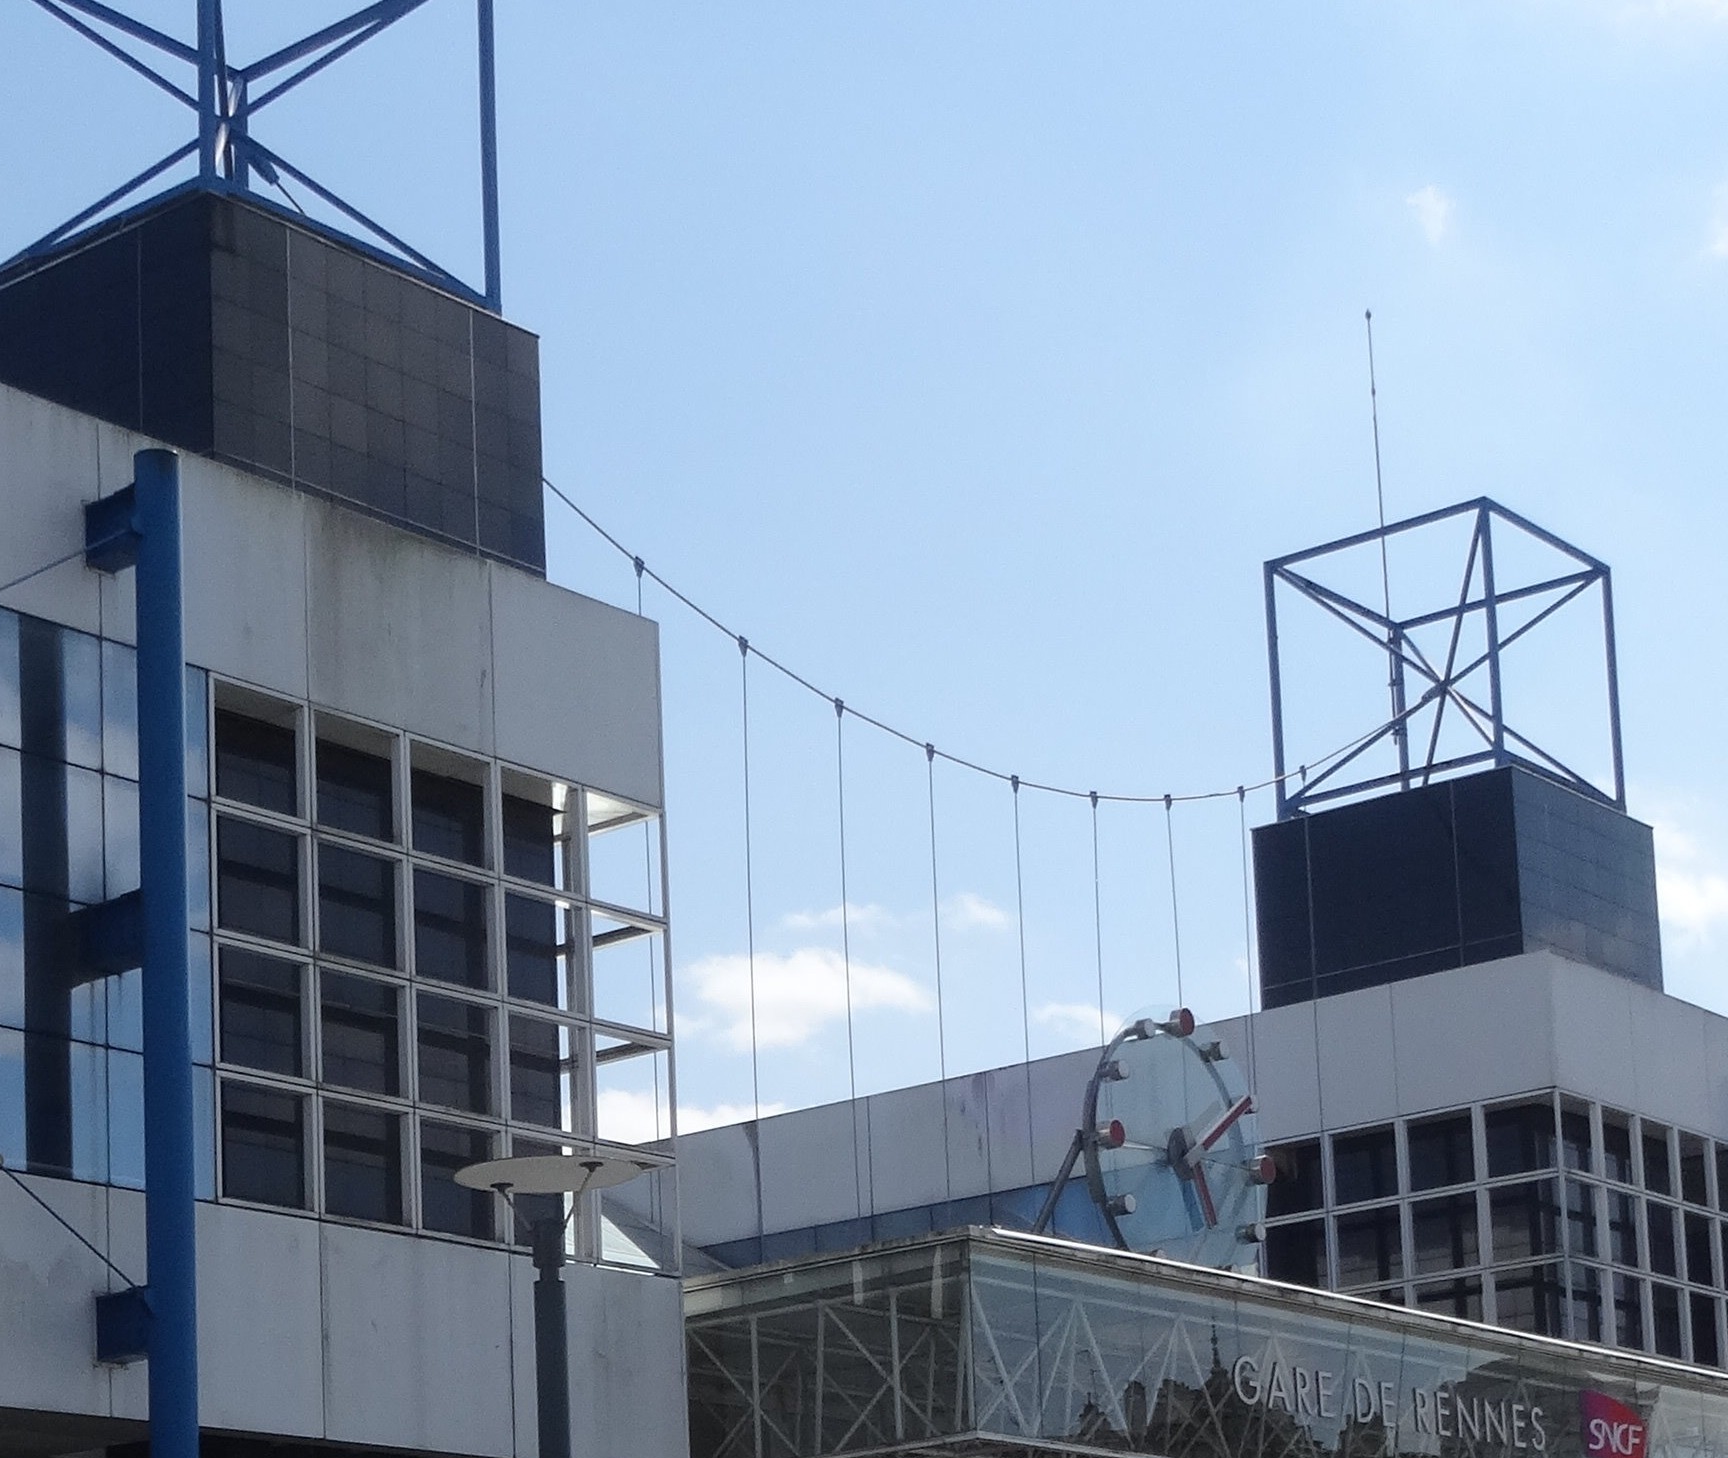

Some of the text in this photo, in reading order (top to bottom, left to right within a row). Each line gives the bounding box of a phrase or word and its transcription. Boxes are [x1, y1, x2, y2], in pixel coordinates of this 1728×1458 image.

[1233, 1355, 1547, 1452] GARE DE RENNES
[1588, 1417, 1645, 1457] SNCF
